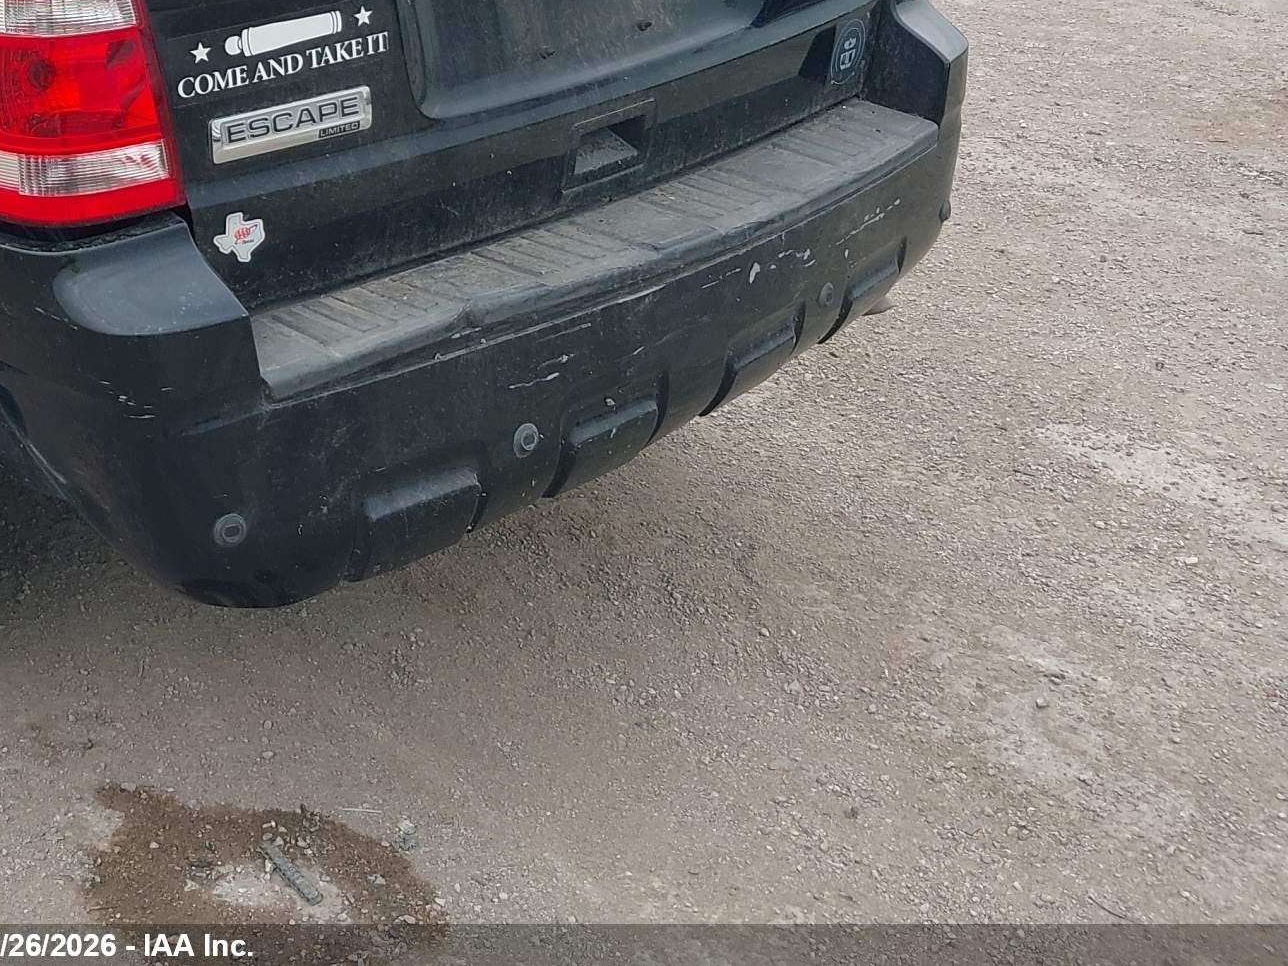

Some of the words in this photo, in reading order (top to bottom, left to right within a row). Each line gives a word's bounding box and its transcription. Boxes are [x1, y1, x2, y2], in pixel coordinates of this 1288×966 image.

[177, 65, 250, 98] COME
[252, 52, 304, 83] AND
[306, 41, 366, 70] TAKE
[367, 31, 389, 56] IT
[226, 96, 360, 144] ESCAPE
[320, 122, 360, 137] LIMITED
